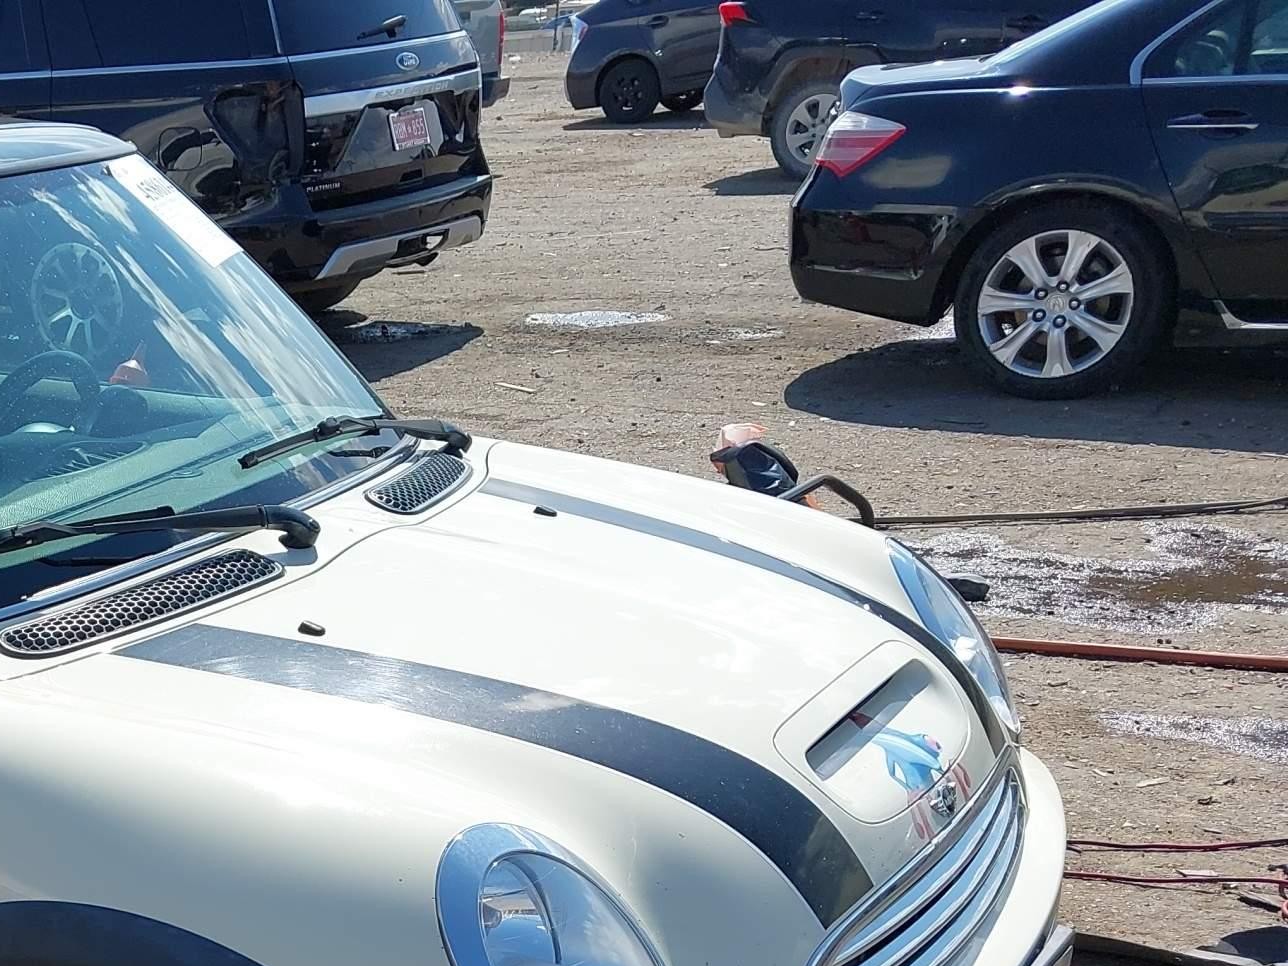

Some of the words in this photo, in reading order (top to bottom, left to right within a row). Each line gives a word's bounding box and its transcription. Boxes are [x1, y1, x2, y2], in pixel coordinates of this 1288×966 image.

[375, 81, 449, 98] EXPEDITION
[412, 118, 425, 136] 855
[306, 182, 341, 193] PLATINUM
